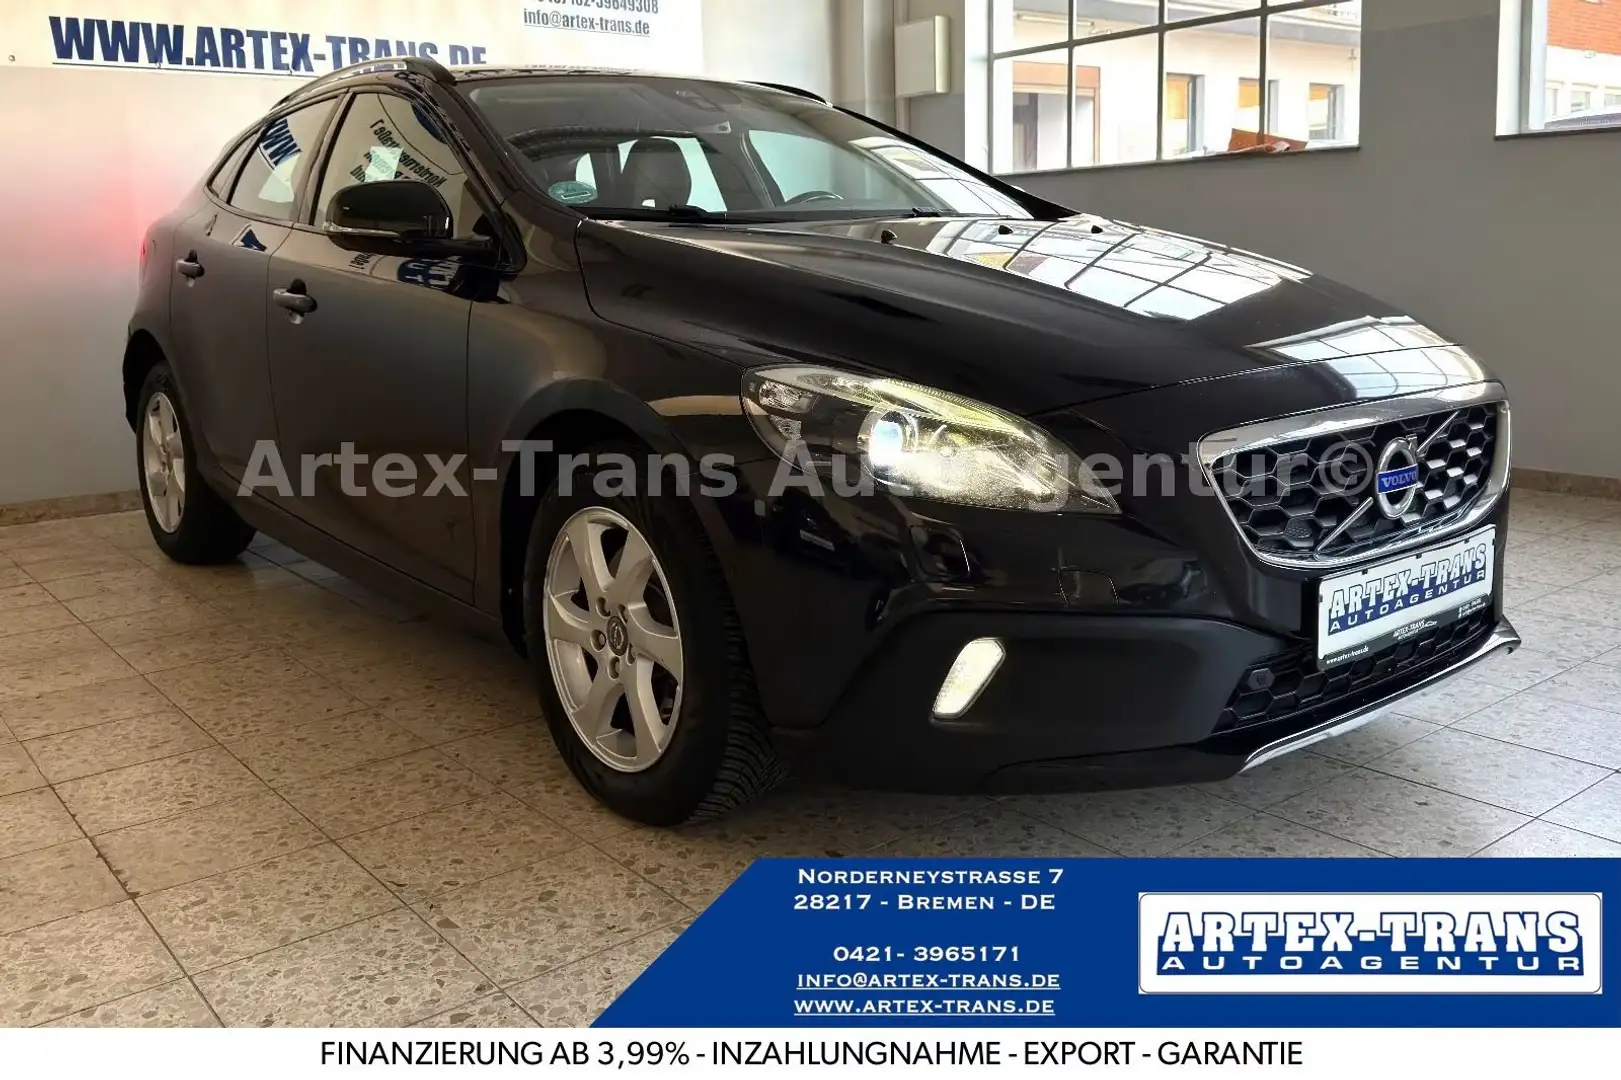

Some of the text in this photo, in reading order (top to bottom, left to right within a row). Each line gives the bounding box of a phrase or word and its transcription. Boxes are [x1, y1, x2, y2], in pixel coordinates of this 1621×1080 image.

[524, 9, 650, 36] info@artex-trans.de
[1381, 471, 1417, 488] VOLVO
[1329, 569, 1487, 632] AUTOAGENTUR
[1330, 542, 1487, 619] ARTEX-TRANS
